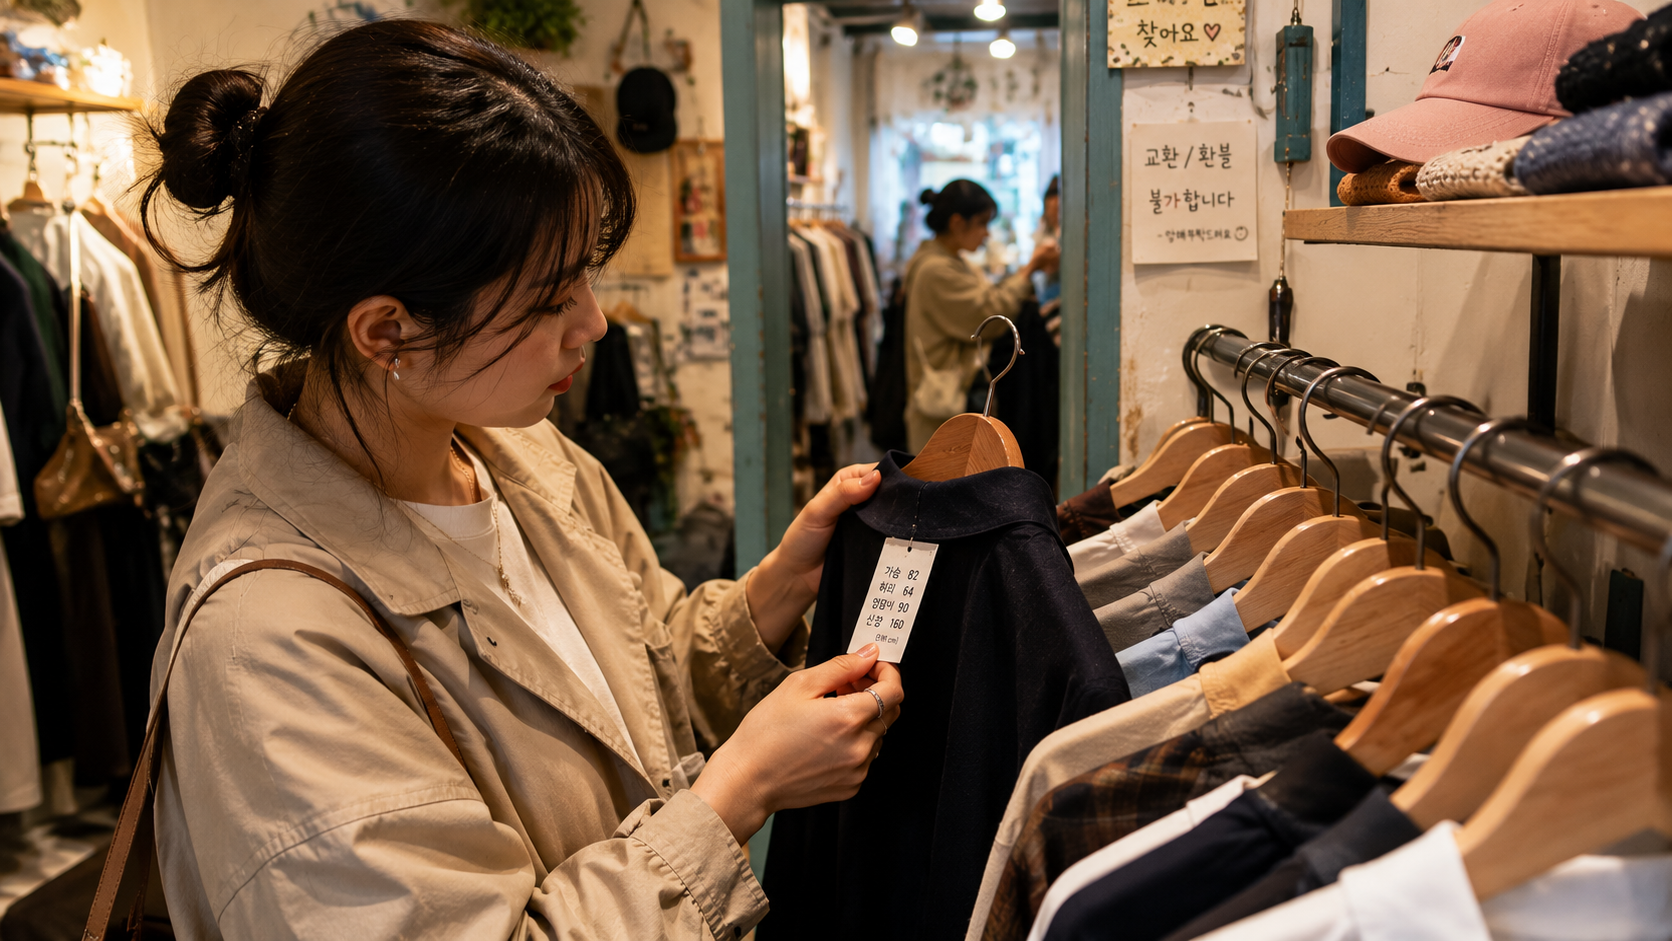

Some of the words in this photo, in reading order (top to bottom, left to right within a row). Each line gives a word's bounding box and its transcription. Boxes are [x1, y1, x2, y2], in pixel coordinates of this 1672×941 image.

[1137, 19, 1199, 48] 찾아요
[1145, 144, 1179, 169] 교환
[1184, 145, 1194, 169] /
[1149, 188, 1235, 215] 불가합니다
[884, 566, 901, 579] 가슴
[907, 569, 920, 581] 82
[902, 585, 915, 597] 64
[897, 602, 910, 613] 90
[889, 618, 905, 630] 160
